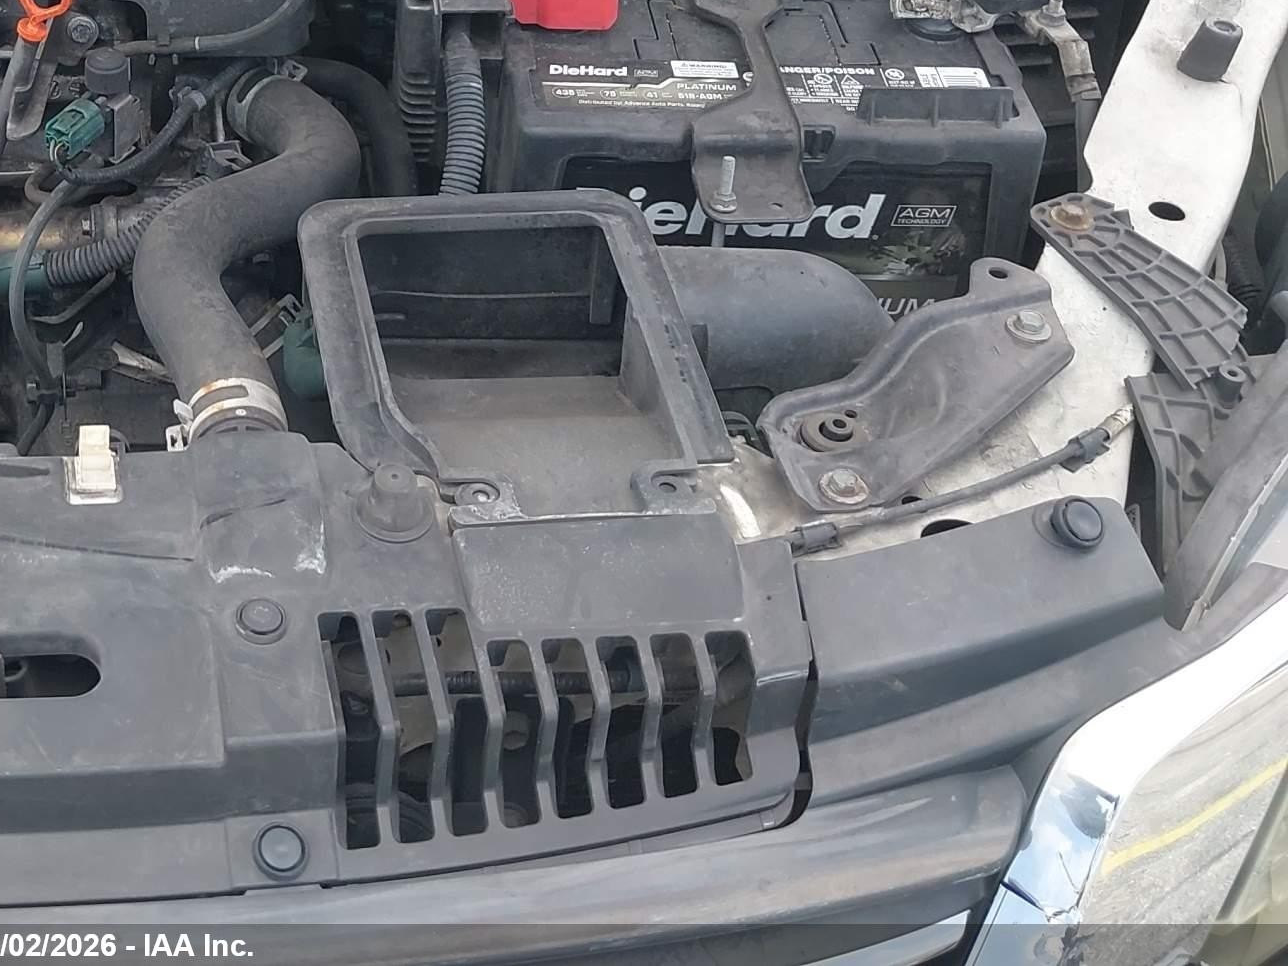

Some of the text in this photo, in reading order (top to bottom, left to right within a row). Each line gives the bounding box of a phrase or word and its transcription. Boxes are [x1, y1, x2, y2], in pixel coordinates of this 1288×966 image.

[549, 64, 628, 77] DieHard
[677, 83, 737, 91] PLATINUM
[899, 208, 951, 218] AGM
